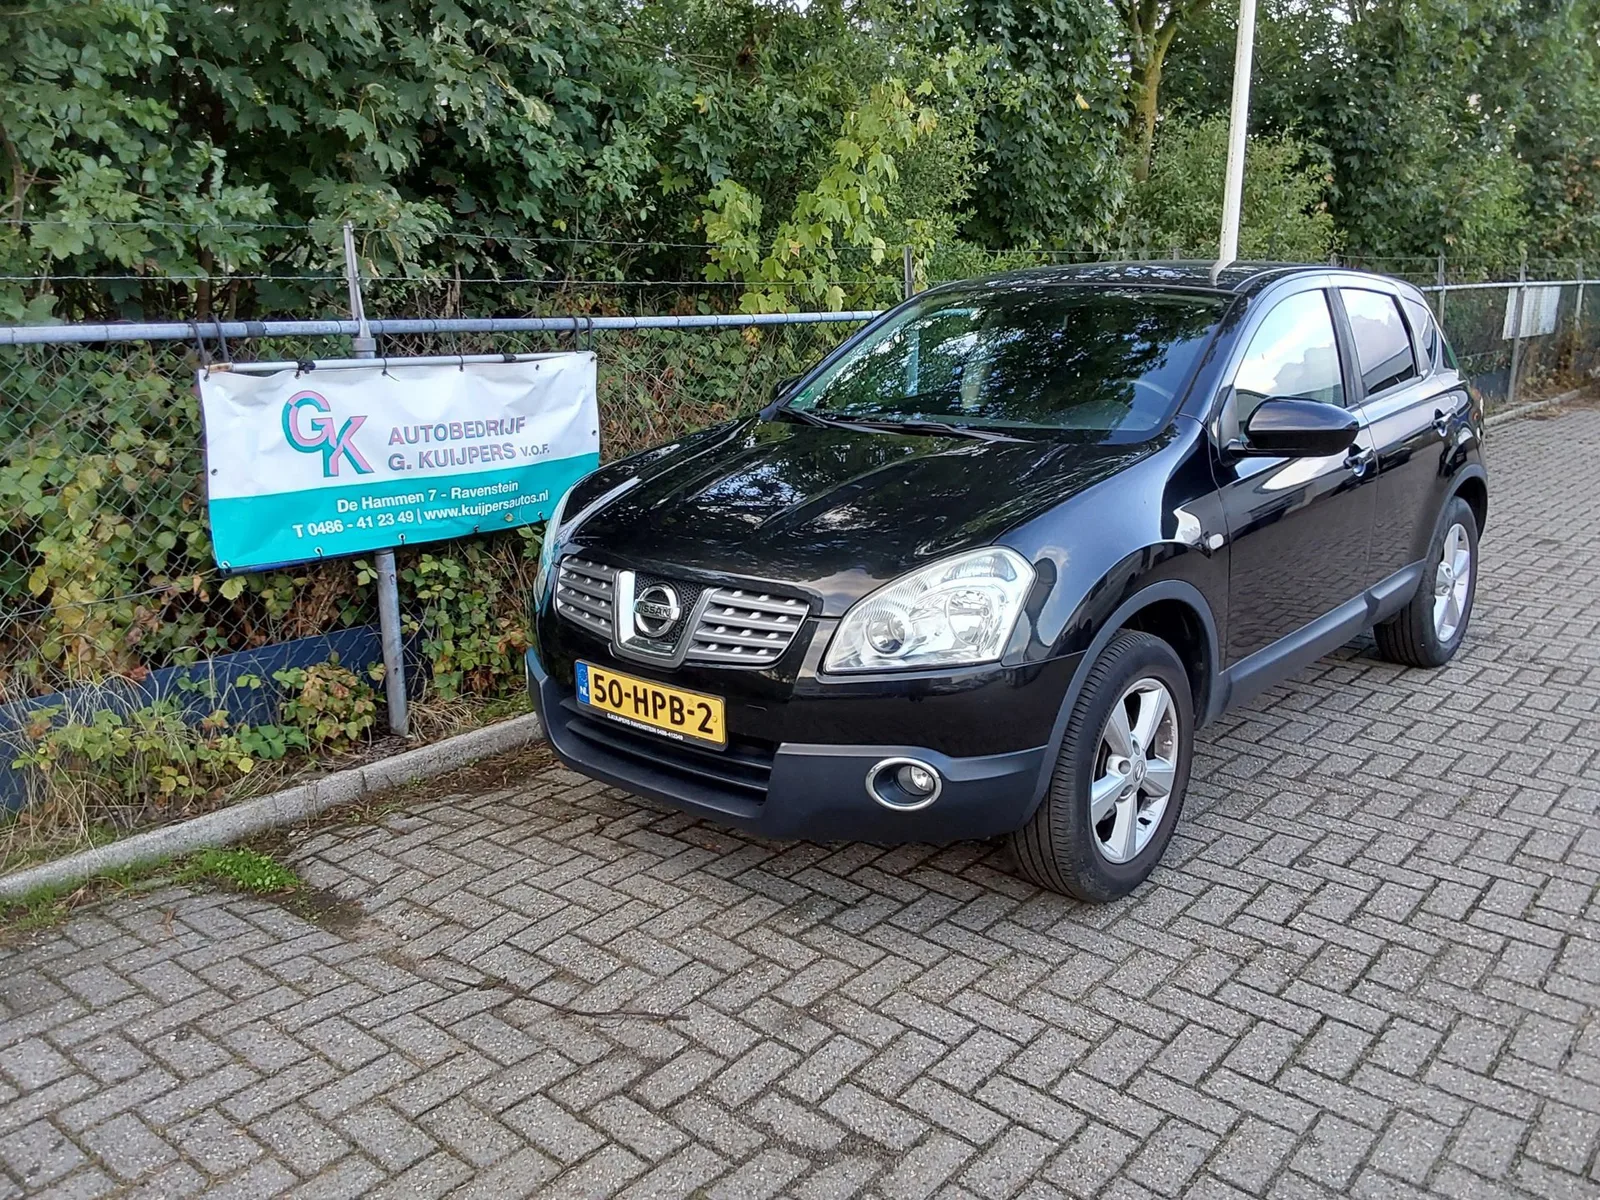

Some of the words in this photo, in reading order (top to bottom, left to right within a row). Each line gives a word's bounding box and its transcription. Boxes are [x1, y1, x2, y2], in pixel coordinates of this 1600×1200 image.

[388, 416, 526, 446] AUTOBEDRIJF
[388, 453, 412, 471] G.
[418, 442, 517, 469] KUIJPERS
[520, 444, 550, 457] V.O.F.
[337, 499, 358, 513] De
[361, 493, 425, 510] Hammen
[428, 489, 437, 502] 7
[451, 480, 519, 500] Ravenstein
[292, 524, 304, 538] T
[307, 519, 344, 536] 0486
[356, 516, 374, 529] 41
[377, 513, 395, 527] 23
[397, 510, 414, 524] 49
[423, 489, 549, 521] www.kuijpersautos.nl
[635, 602, 674, 618] NISSAN
[579, 686, 589, 697] NL
[593, 673, 714, 735] 50-HPB-2
